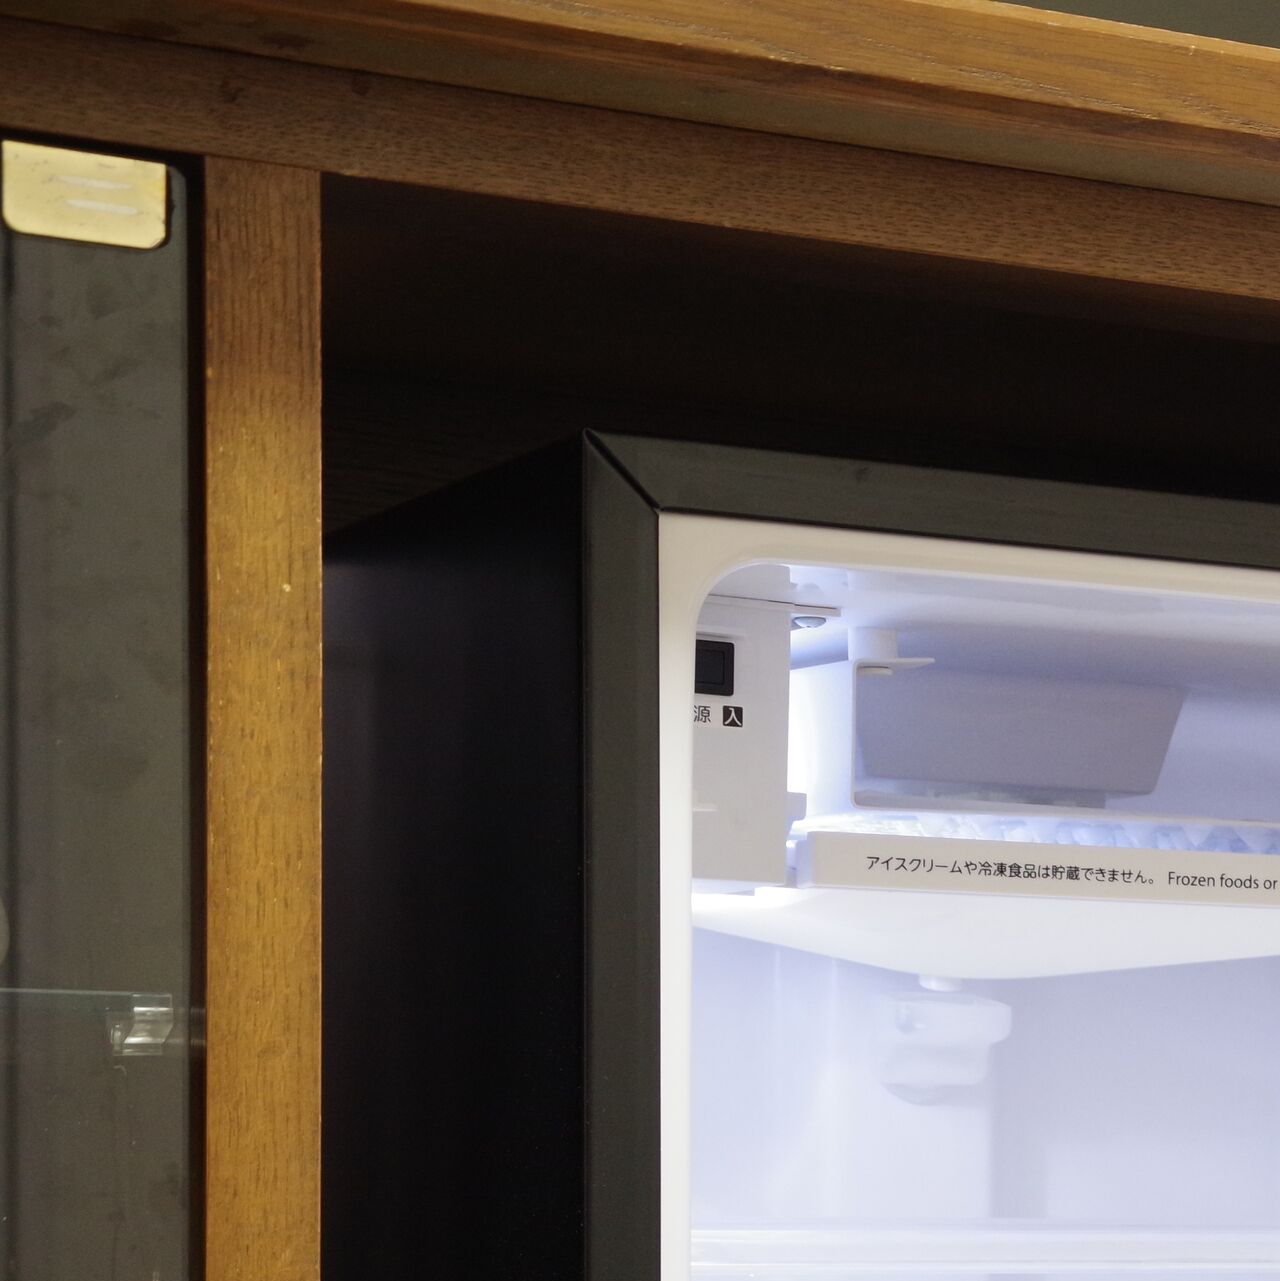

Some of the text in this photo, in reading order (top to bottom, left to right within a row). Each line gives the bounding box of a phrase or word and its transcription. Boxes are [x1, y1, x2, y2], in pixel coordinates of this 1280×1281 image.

[724, 706, 743, 727] 入
[866, 856, 1153, 885] アイスクリームや冷凍食品は貯蔵できません。
[1168, 871, 1215, 887] Frozen
[1220, 873, 1259, 889] foods
[1263, 879, 1278, 890] or
